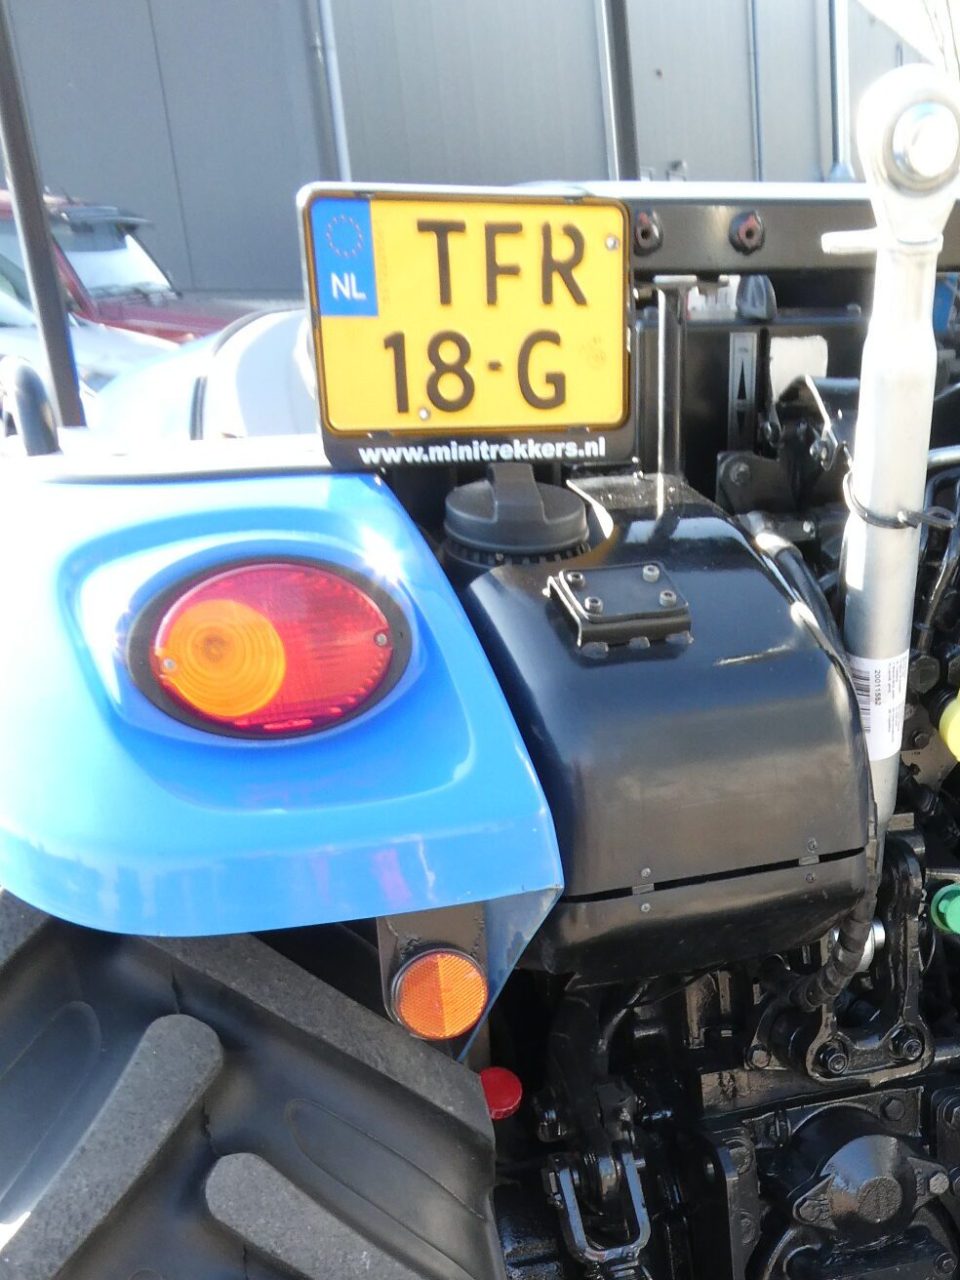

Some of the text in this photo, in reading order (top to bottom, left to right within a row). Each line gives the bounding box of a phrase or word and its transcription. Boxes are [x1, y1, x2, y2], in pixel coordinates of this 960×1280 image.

[331, 272, 367, 300] NL
[417, 219, 588, 306] TFR
[383, 329, 567, 414] 18-G
[358, 436, 606, 465] www.minitrekkers.nl
